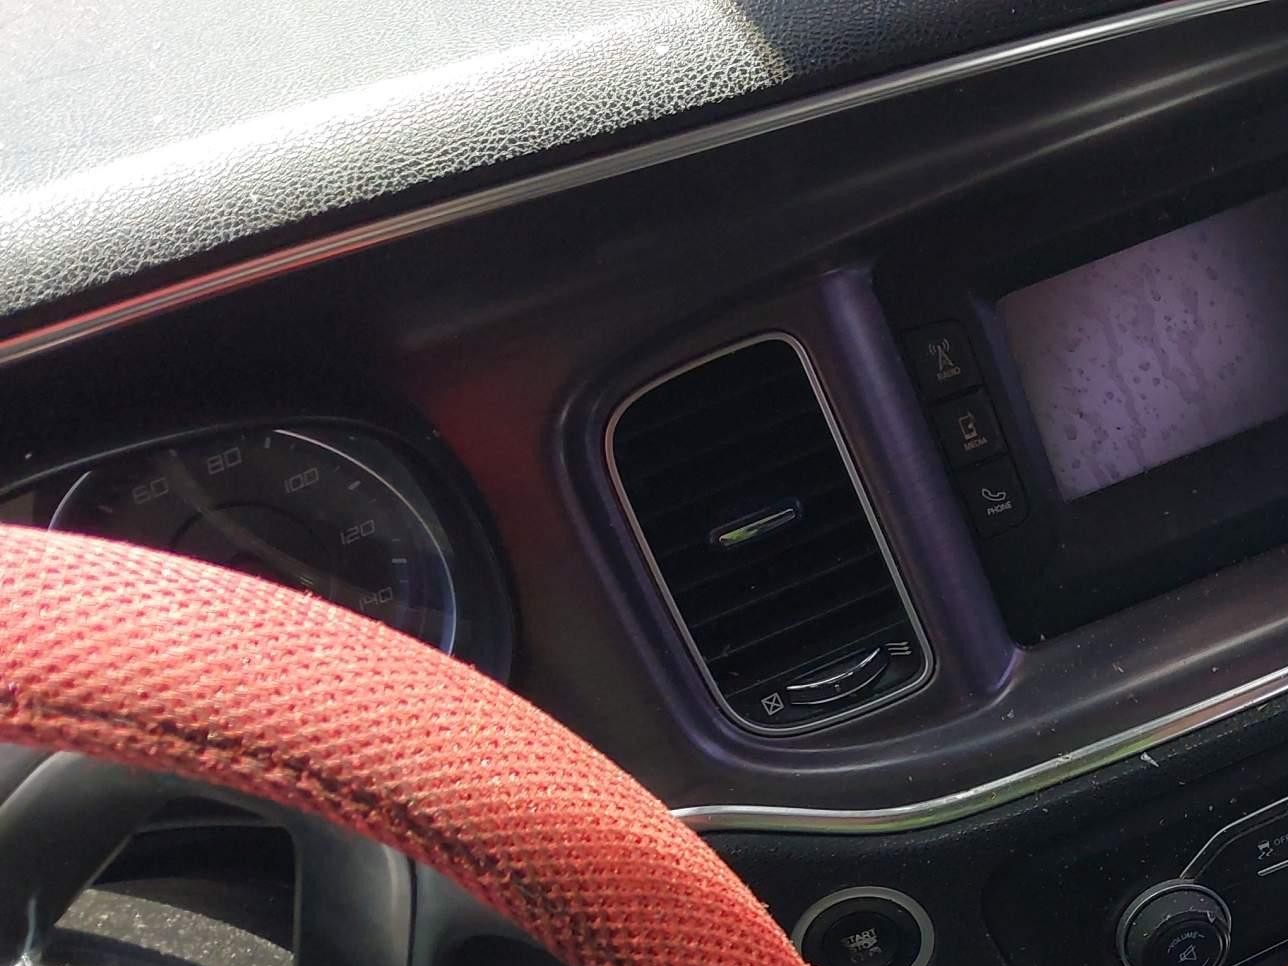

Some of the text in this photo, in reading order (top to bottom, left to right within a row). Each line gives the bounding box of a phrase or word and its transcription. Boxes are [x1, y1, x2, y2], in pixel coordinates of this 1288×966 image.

[206, 447, 242, 475] 80
[131, 476, 169, 505] 60
[284, 467, 320, 494] 100
[986, 500, 1013, 516] PHONE
[340, 519, 376, 546] 120
[358, 586, 393, 611] 140
[1168, 931, 1199, 947] VOLUME
